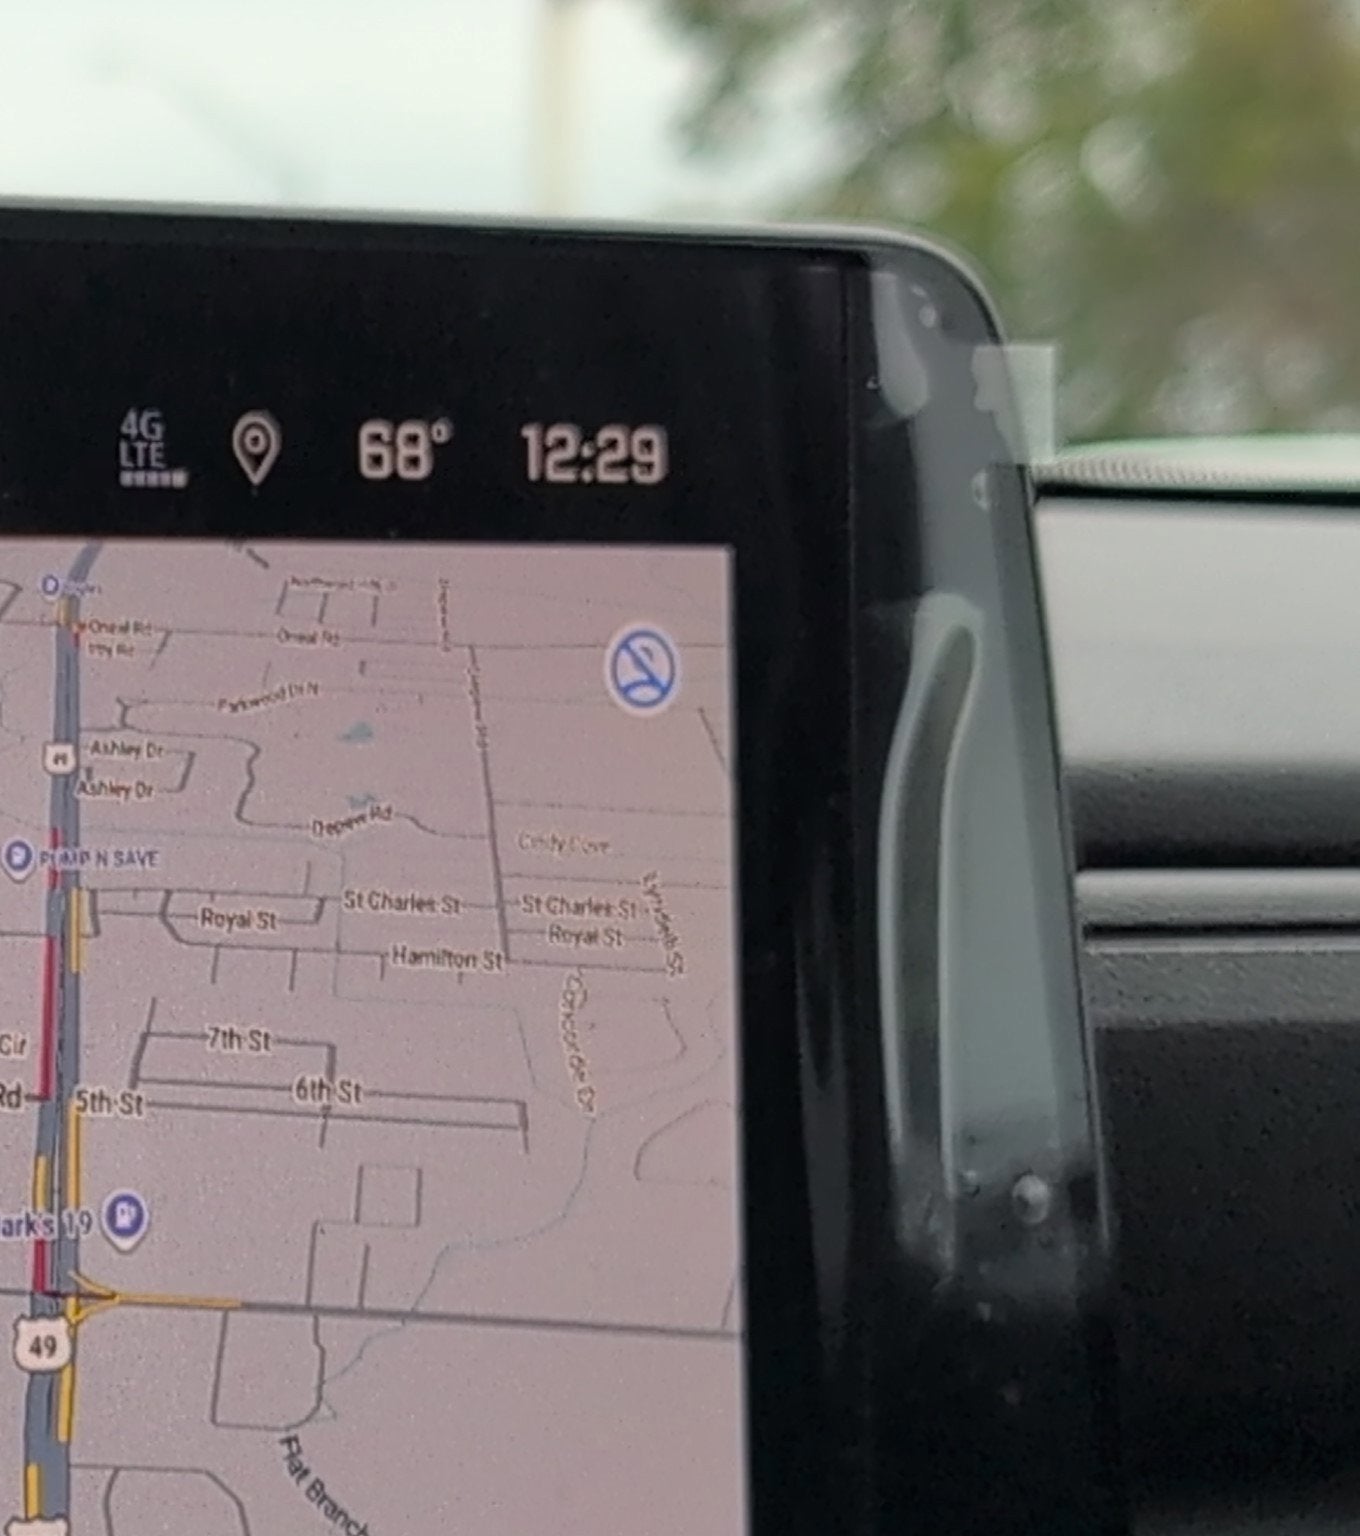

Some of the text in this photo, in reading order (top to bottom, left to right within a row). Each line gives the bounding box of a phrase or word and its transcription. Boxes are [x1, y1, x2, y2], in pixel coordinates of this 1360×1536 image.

[121, 409, 164, 440] 4G
[119, 441, 166, 469] LTE
[520, 424, 670, 485] 12:29
[113, 851, 160, 867] SAVE
[343, 890, 365, 909] St
[440, 896, 461, 914] St
[522, 895, 541, 914] St
[619, 900, 637, 919] St
[200, 908, 277, 934] Royal St
[549, 924, 623, 947] Royal St
[391, 945, 503, 971] Hamilton St
[208, 1028, 271, 1052] 7th St
[295, 1076, 362, 1104] 6th St
[75, 1090, 144, 1117] 5th St
[28, 1333, 58, 1358] 49
[282, 1435, 311, 1485] Flat
